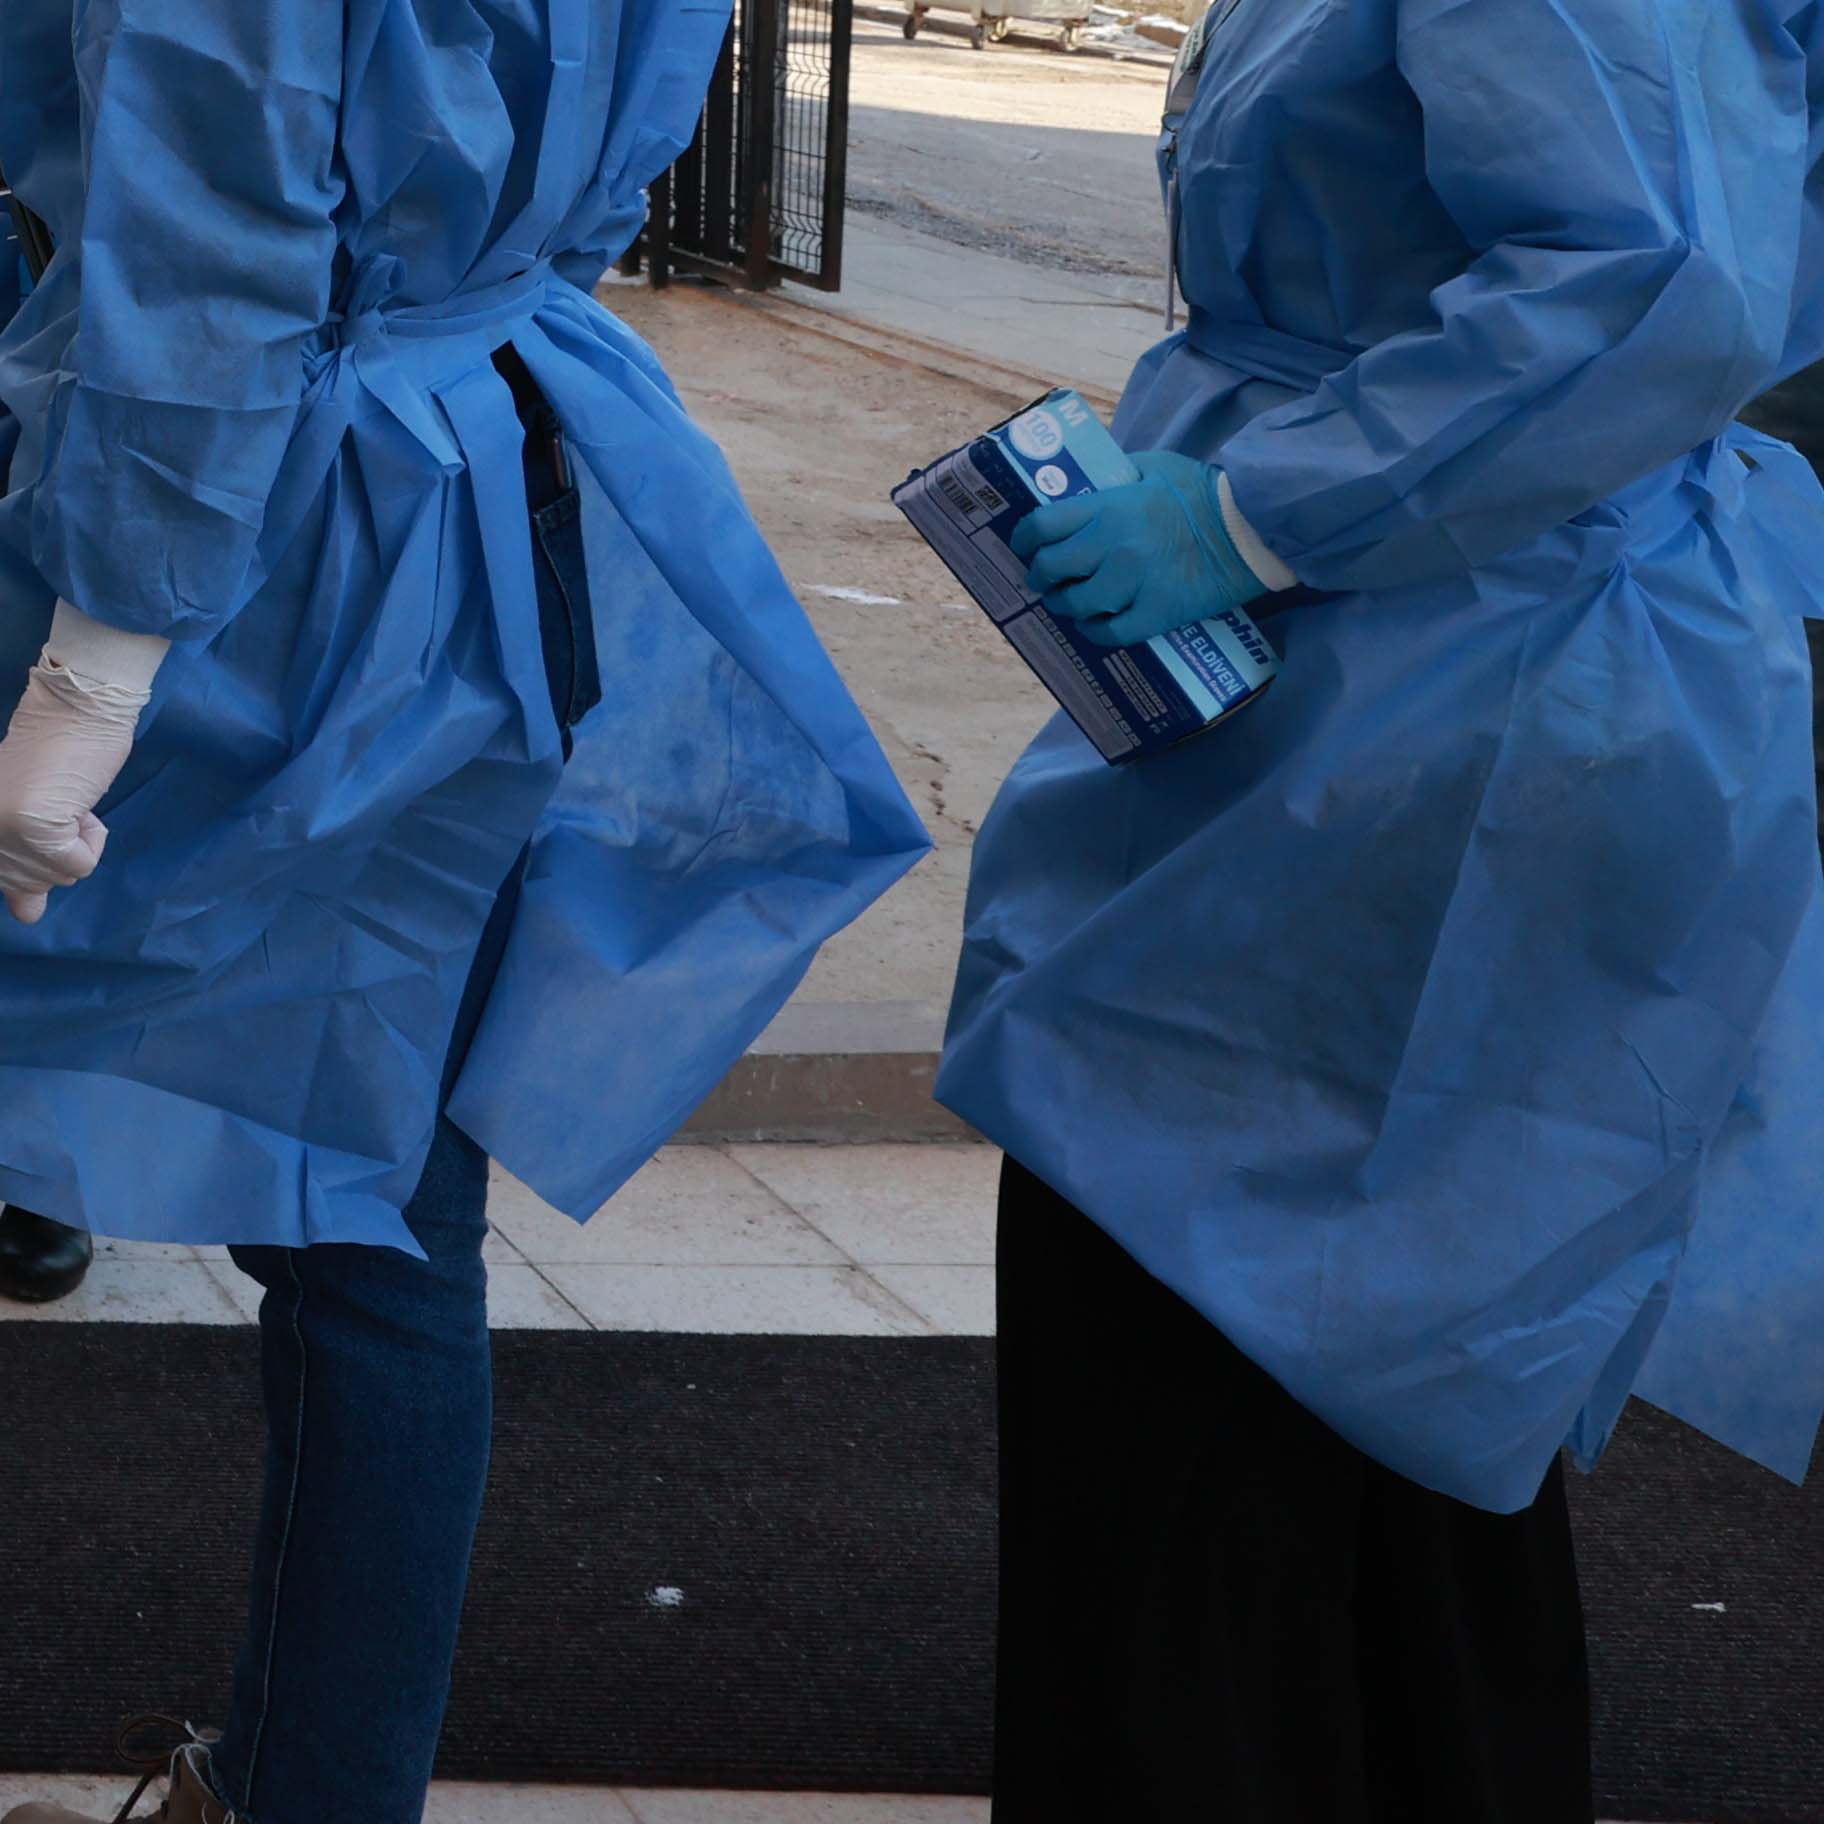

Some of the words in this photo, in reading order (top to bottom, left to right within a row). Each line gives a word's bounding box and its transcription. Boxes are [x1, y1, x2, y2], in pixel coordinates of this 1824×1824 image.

[1059, 399, 1089, 428] M
[1026, 414, 1057, 447] 100
[1210, 611, 1269, 665] phin
